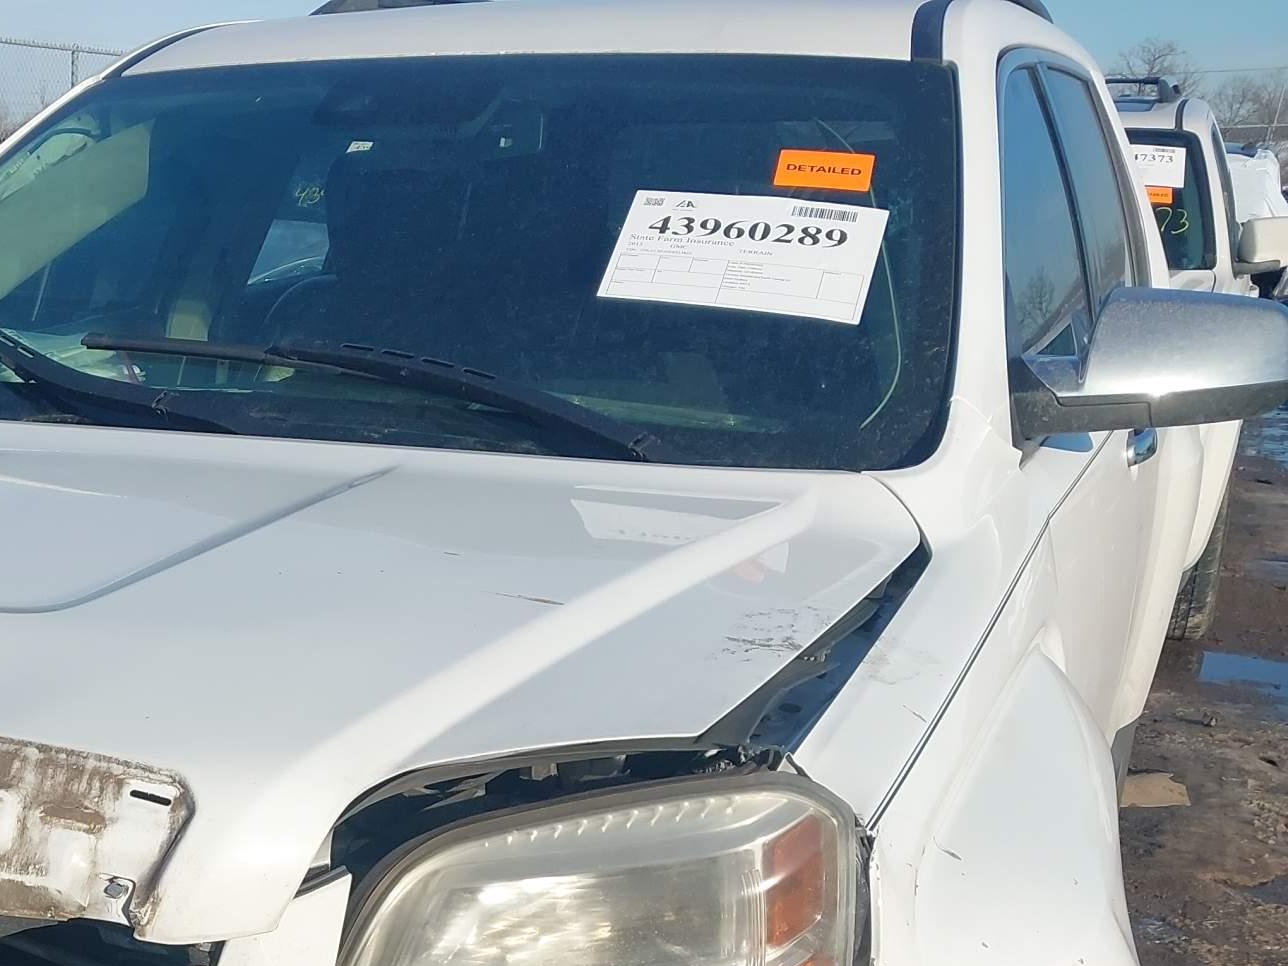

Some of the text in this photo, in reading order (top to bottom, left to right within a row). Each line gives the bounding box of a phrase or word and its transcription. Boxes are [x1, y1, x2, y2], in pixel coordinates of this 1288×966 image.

[786, 163, 862, 176] DETAILED
[1156, 207, 1189, 234] 73
[630, 233, 735, 247] State Farm Insurance
[648, 214, 848, 249] 43960289
